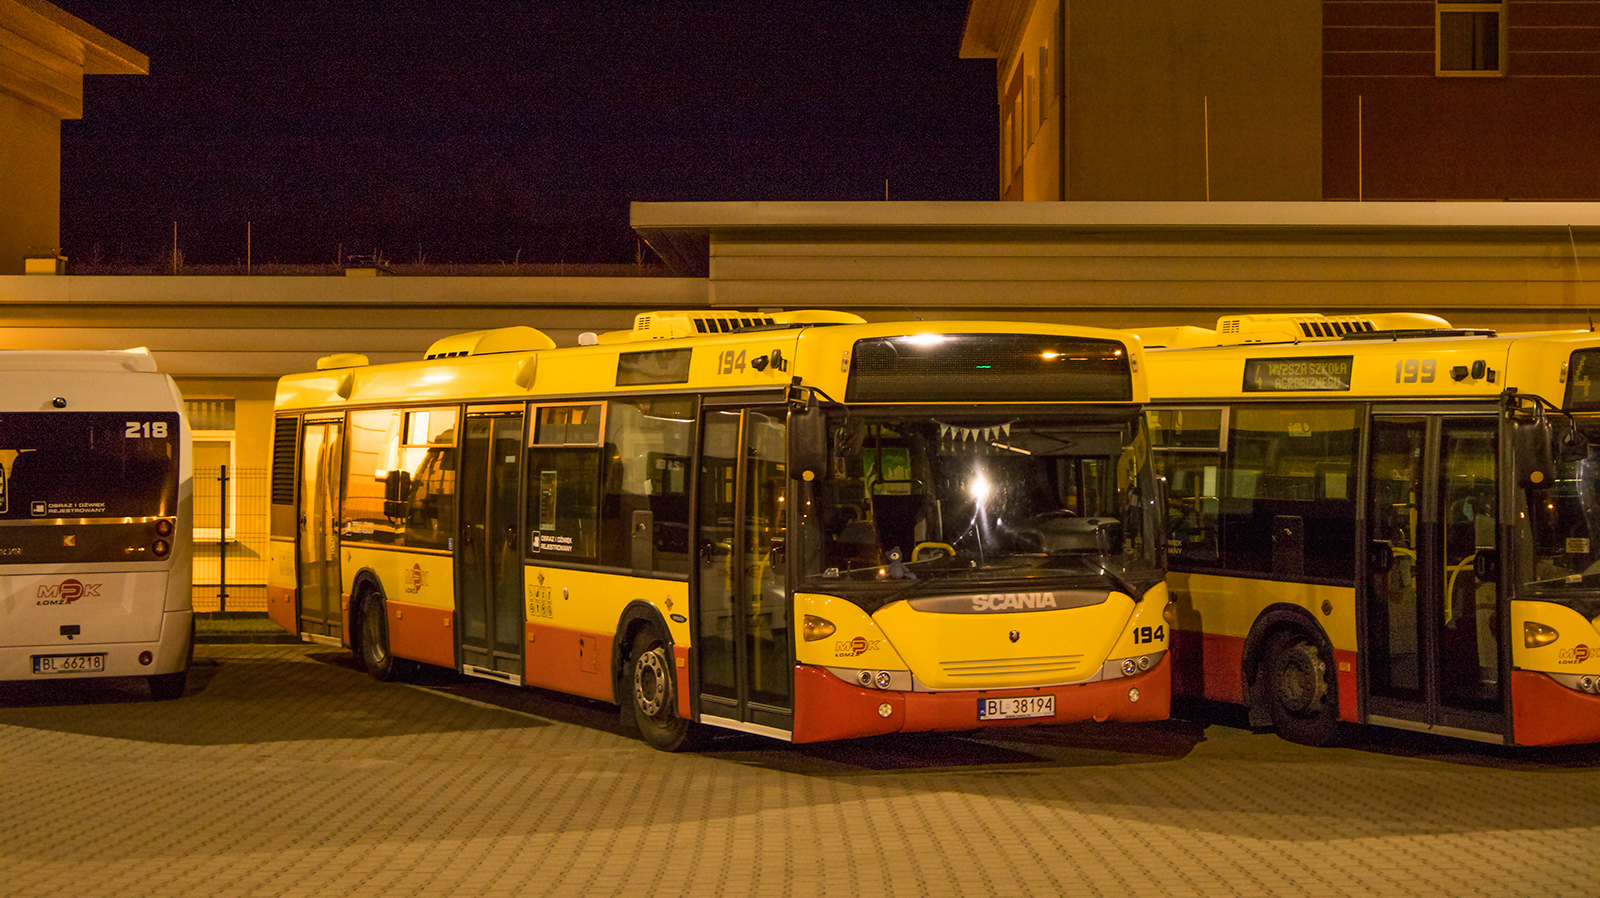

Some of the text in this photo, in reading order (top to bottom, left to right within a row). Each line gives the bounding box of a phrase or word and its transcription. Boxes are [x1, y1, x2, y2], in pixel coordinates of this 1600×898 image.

[717, 349, 747, 376] 194
[1394, 358, 1437, 384] 199
[1254, 364, 1263, 390] 4
[1308, 362, 1347, 375] SZKOŁA
[1573, 354, 1591, 397] 4
[124, 421, 168, 439] 218
[37, 578, 103, 602] MPK
[972, 592, 1057, 612] SCANIA
[1133, 624, 1165, 645] 194
[834, 636, 881, 655] MPK
[42, 656, 101, 671] BL 66218
[988, 697, 1053, 716] BL 38194
